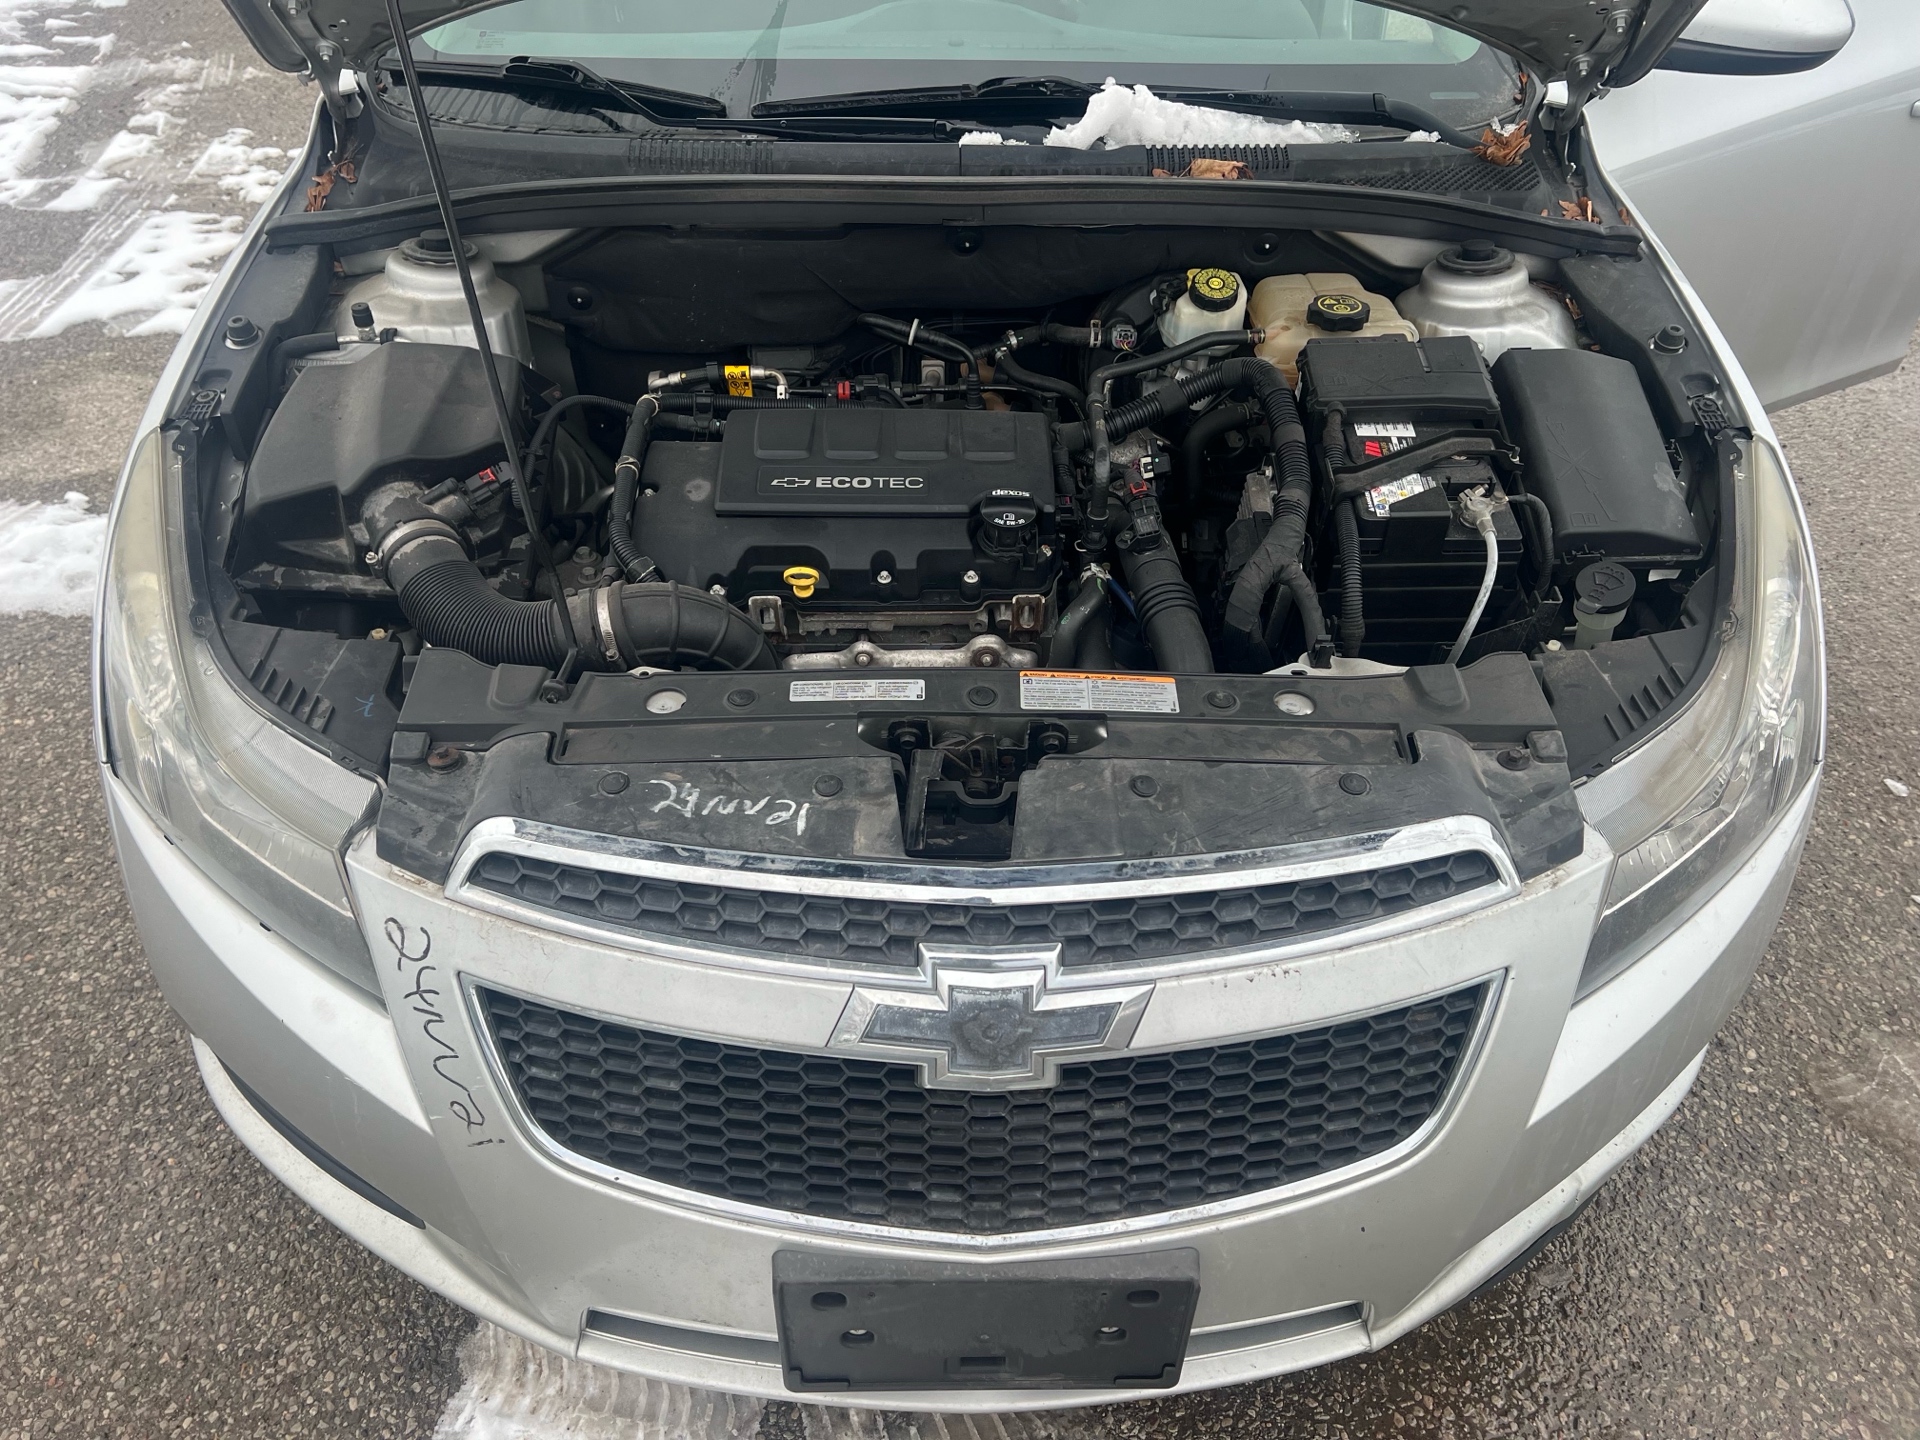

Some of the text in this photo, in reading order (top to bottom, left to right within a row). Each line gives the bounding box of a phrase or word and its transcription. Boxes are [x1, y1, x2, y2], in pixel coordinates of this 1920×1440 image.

[815, 475, 924, 490] ECOTEC
[991, 488, 1031, 498] dexos
[993, 517, 1005, 526] SAE
